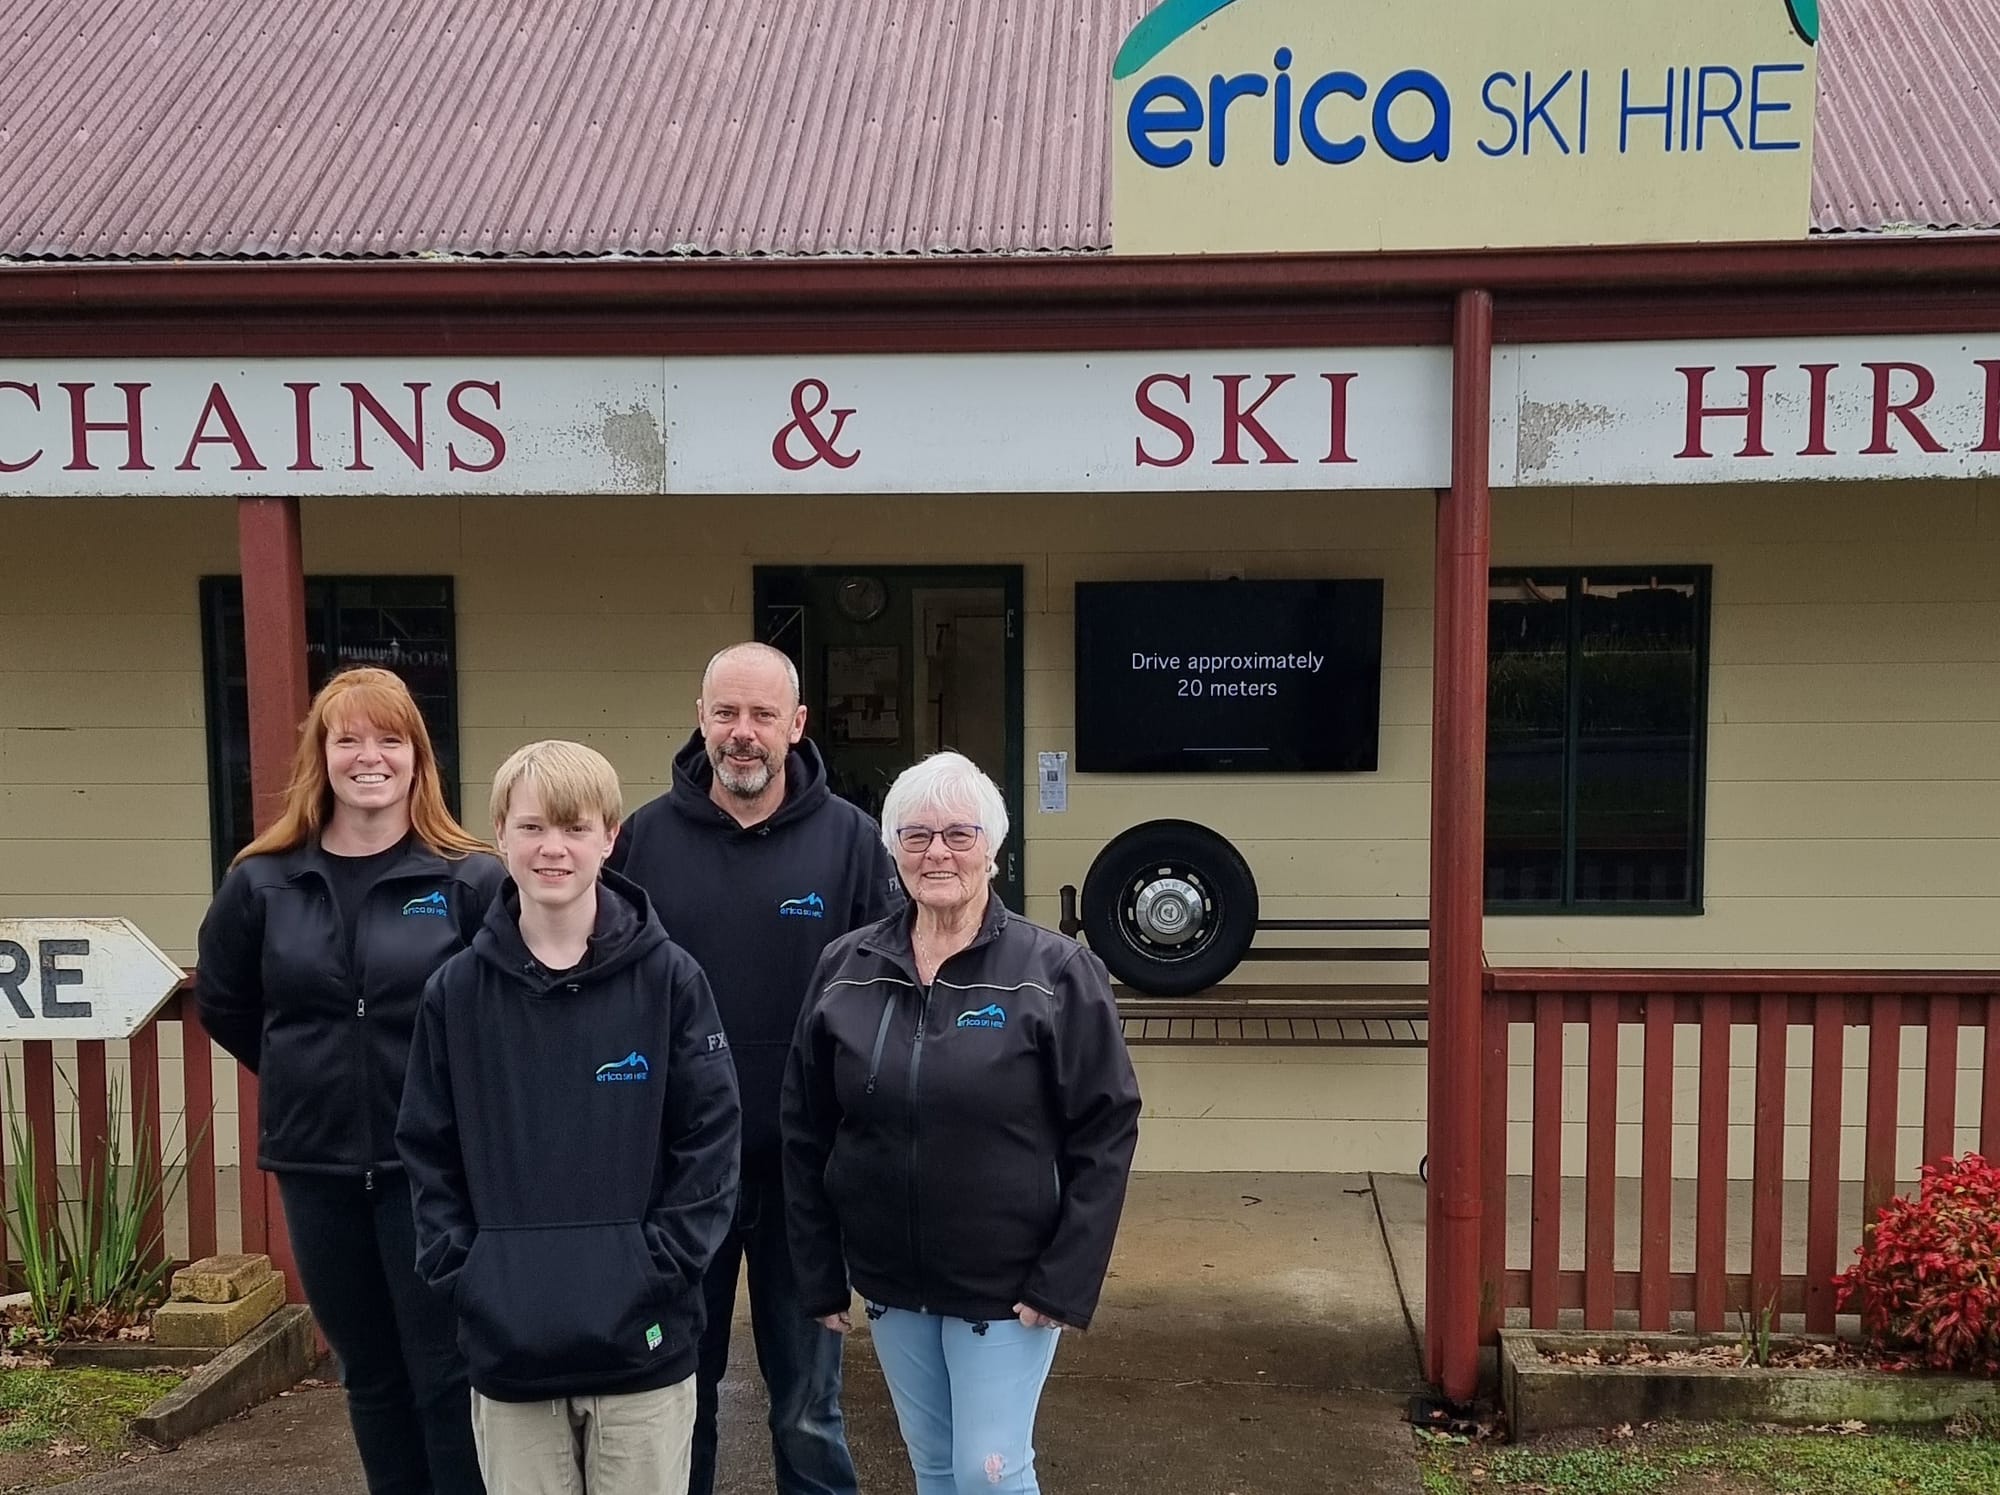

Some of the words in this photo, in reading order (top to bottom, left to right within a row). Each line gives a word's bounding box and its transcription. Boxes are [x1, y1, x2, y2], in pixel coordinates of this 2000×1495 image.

[1126, 46, 1451, 168] erica
[1477, 69, 1588, 158] SKI
[1619, 63, 1805, 154] HIRE
[771, 377, 861, 471] &
[1135, 373, 1359, 467] SKI
[1131, 652, 1181, 670] Drive
[1187, 651, 1324, 673] approximately
[1177, 679, 1203, 697] 20
[1210, 680, 1278, 697] meters
[596, 1071, 623, 1082] erica
